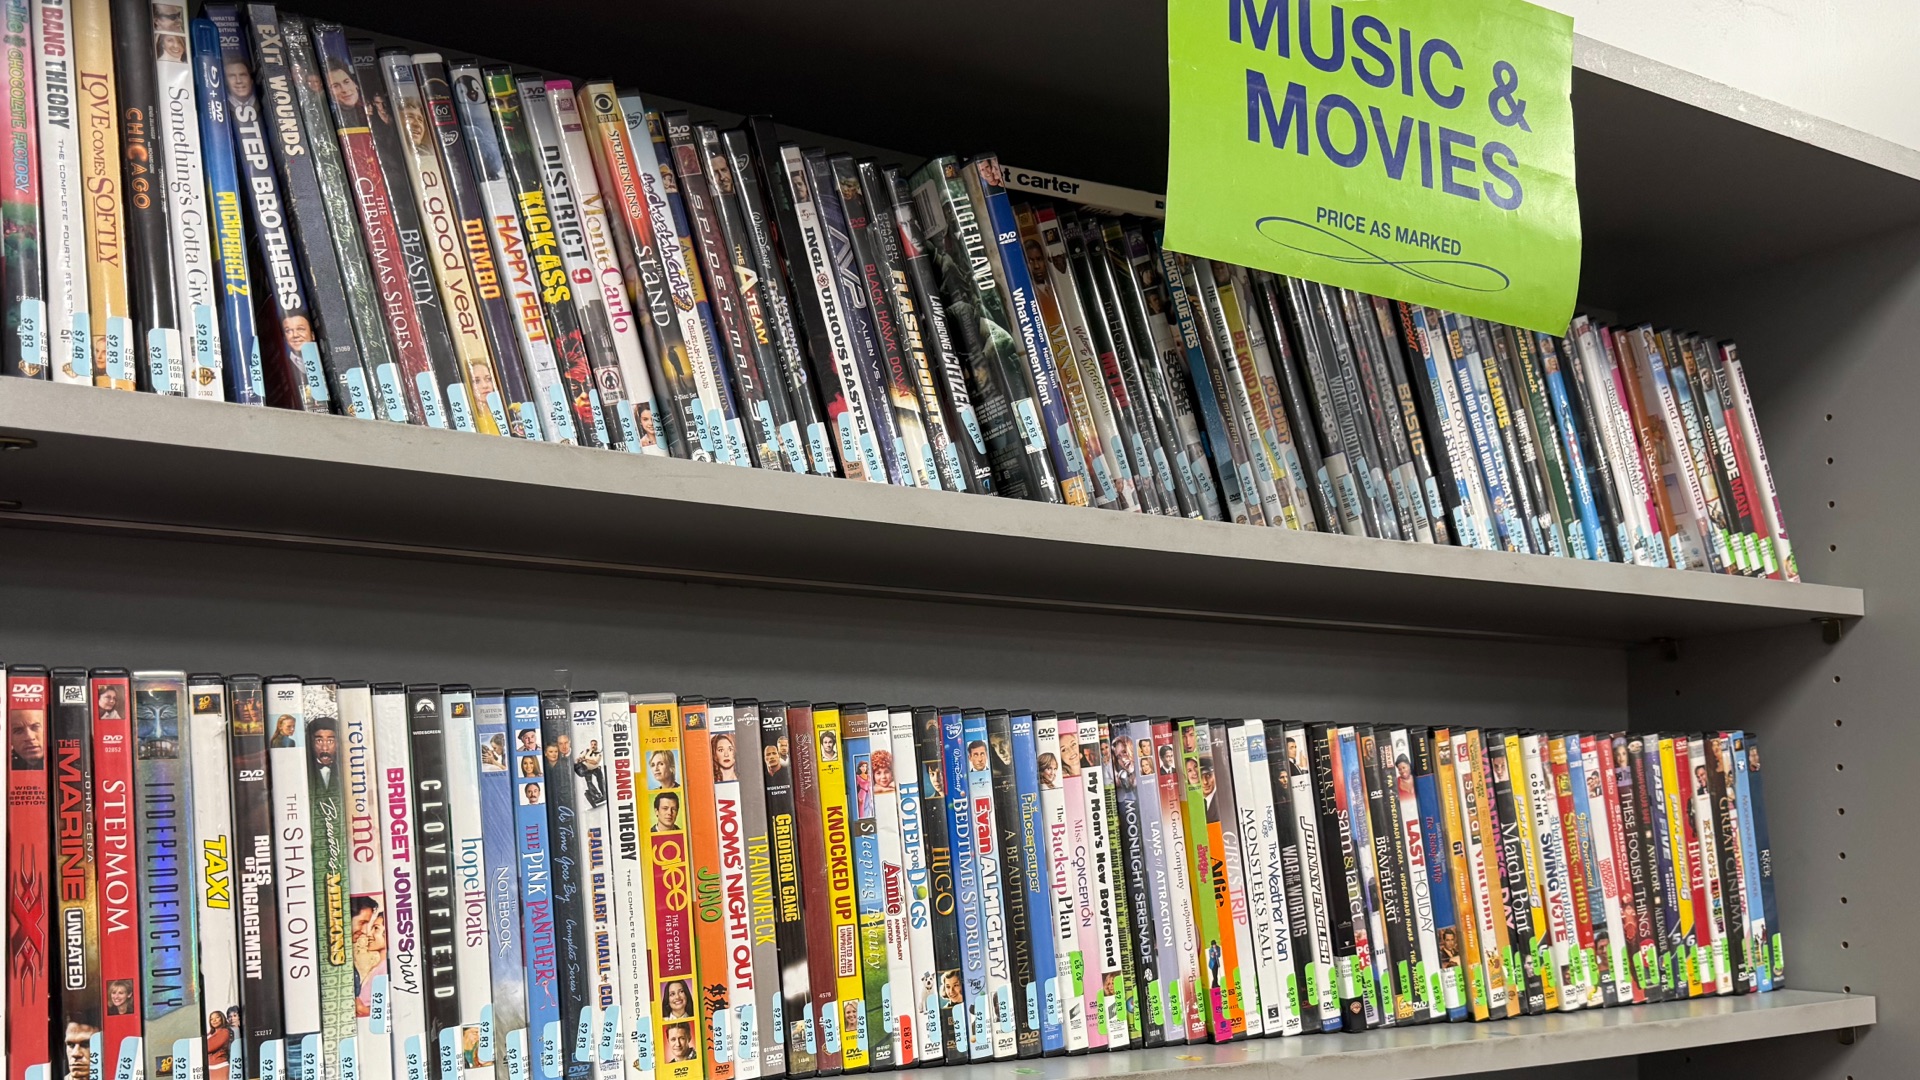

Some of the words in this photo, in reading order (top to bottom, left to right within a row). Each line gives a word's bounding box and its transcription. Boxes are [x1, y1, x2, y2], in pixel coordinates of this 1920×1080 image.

[41, 9, 65, 57] BANG
[257, 24, 283, 65] EXIT
[44, 60, 69, 130] THEORY
[1229, 0, 1465, 109] MUSIC
[1488, 60, 1532, 132] &
[80, 69, 111, 131] LOVE
[269, 76, 305, 157] WOUNDS
[12, 132, 30, 194] FACTORY
[91, 130, 106, 177] COMES
[125, 107, 151, 210] CHICAGO
[235, 105, 268, 171] STEP
[1246, 69, 1524, 211] MOVIES
[377, 195, 388, 215] THE
[421, 170, 438, 191] a
[1016, 170, 1081, 196] carter
[87, 176, 119, 269] SOFTLY
[251, 172, 301, 311] BROTHERS
[354, 176, 396, 285] CHRISTMAS
[423, 196, 464, 270] good
[539, 146, 587, 262] DISTRICT
[571, 267, 593, 285] 9
[952, 193, 996, 293] TIGERLAND
[1316, 206, 1366, 235] PRICE
[1370, 220, 1392, 239] AS
[1395, 227, 1462, 256] MARKED
[401, 228, 436, 309] BEASTLY
[462, 218, 500, 300] DUMBO
[518, 191, 572, 305] KICK-ASS
[582, 192, 610, 272] Monte
[602, 267, 632, 333] Carlo
[734, 243, 746, 266] THE
[452, 279, 479, 341] year
[494, 215, 533, 287] HAPPY
[516, 292, 548, 346] FEET
[732, 264, 769, 345] A-TEAM
[1012, 287, 1033, 326] What
[23, 318, 34, 349] $2.83
[73, 329, 85, 359] $7.48
[107, 334, 119, 364] $2.83
[198, 323, 209, 353] $2.83
[384, 290, 414, 352] SHOES
[864, 263, 885, 306] BLACK
[877, 309, 898, 353] HAWK
[889, 357, 911, 399] DOWN
[1020, 325, 1043, 373] Women
[1030, 300, 1038, 315] Mel
[1034, 314, 1047, 342] Gibson
[1043, 347, 1054, 369] Helen
[1050, 370, 1059, 390] Hunt
[1234, 331, 1245, 352] BE
[150, 347, 162, 377] $2.83
[305, 361, 319, 389] $2.83
[1035, 373, 1052, 406] Want
[1238, 353, 1258, 391] KIND
[1459, 367, 1471, 391] WHEN
[1717, 367, 1731, 406] JESUS
[693, 415, 707, 440] $2.83
[1212, 368, 1226, 405] BONUS
[1222, 402, 1240, 450] MATERIAL
[1262, 375, 1278, 404] JOE
[1272, 407, 1292, 445] DIRT
[1397, 383, 1425, 456] BASIC
[1453, 401, 1468, 440] LOVE
[1463, 392, 1477, 413] BOB
[1480, 394, 1497, 447] BOURNE
[1486, 366, 1511, 430] LEAGUE
[711, 425, 723, 451] $2.83
[840, 427, 852, 451] $2.83
[967, 422, 981, 445] $2.83
[1470, 411, 1486, 447] BECAME
[1661, 385, 1677, 422] maid
[1678, 437, 1704, 512] manhattan
[1704, 415, 1718, 456] BOURNE
[865, 449, 878, 472] $2.83
[1481, 453, 1498, 488] BUILDER
[1716, 427, 1740, 482] INSIDE
[1730, 478, 1750, 518] MAN
[347, 721, 368, 797] return
[1087, 772, 1099, 793] My
[58, 747, 85, 901] MARINE
[286, 793, 298, 821] THE
[355, 798, 369, 813] to
[386, 767, 410, 863] BRIDGET
[717, 799, 744, 871] MOMS'
[974, 797, 992, 854] Evan
[1090, 798, 1104, 848] Mom's
[1620, 790, 1635, 829] THESE
[102, 780, 130, 936] STEPMOM
[244, 857, 256, 873] OF
[254, 835, 272, 886] RULES
[319, 798, 342, 875] Brewster's
[352, 814, 374, 864] me
[457, 837, 483, 890] hope
[525, 824, 540, 850] THE
[774, 814, 793, 882] GRIDIRON
[827, 806, 849, 897] KNOCKED
[860, 823, 879, 899] Sleeping
[952, 797, 974, 888] BEDTIME
[1125, 800, 1144, 889] MOONLIGHT
[1222, 831, 1241, 886] GIRLS
[1405, 819, 1423, 866] LAST
[1500, 821, 1524, 884] Match
[1540, 832, 1563, 892] SWING
[1627, 832, 1643, 885] FOOLISH
[1687, 840, 1704, 891] HITCH
[144, 783, 181, 955] INDEPENDENCE
[203, 834, 231, 910] TAXI
[420, 780, 455, 999] CLOVERFIELD
[522, 849, 549, 896] PINK
[651, 840, 689, 912] glee
[697, 867, 723, 923] JUNO
[747, 832, 776, 946] TRAINWRECK
[884, 862, 903, 914] Annie
[931, 846, 955, 916] HUGO
[1005, 846, 1026, 936] BEAUTIFUL
[1095, 852, 1107, 884] New
[1244, 808, 1268, 916] MONSTER'S
[1258, 923, 1273, 968] BALL
[1300, 816, 1322, 891] JOHNNY
[1312, 892, 1330, 964] ENGLISH
[1374, 835, 1398, 924] BRAVEHEART
[241, 873, 262, 980] ENGAGEMENT
[282, 827, 311, 980] SHALLOWS
[325, 873, 346, 966] MILLIONS
[393, 866, 416, 952] JONES'S
[464, 889, 486, 948] floats
[725, 874, 749, 940] NIGHT
[782, 884, 799, 922] GANG
[835, 900, 851, 921] UP
[961, 891, 982, 971] STORIES
[980, 856, 1007, 980] ALMIGHTY
[1099, 889, 1116, 967] Boyfriend
[1134, 893, 1151, 964] SERENADE
[1229, 889, 1247, 926] TRIP
[1287, 883, 1308, 937] WORLDS
[1412, 870, 1433, 933] HOLIDAY
[1509, 887, 1531, 935] Point
[1548, 895, 1568, 943] VOTE
[1633, 887, 1651, 938] THINGS
[66, 910, 83, 987] UNRATED
[525, 898, 556, 984] PANTHER
[734, 944, 753, 991] OUT
[866, 907, 881, 969] Beauty
[1014, 940, 1031, 988] MIND
[151, 968, 183, 1008] DAY
[393, 949, 420, 994] Diary
[371, 992, 383, 1020] $2.83
[545, 1040, 554, 1066] $2.83
[638, 1033, 647, 1058] $7.48
